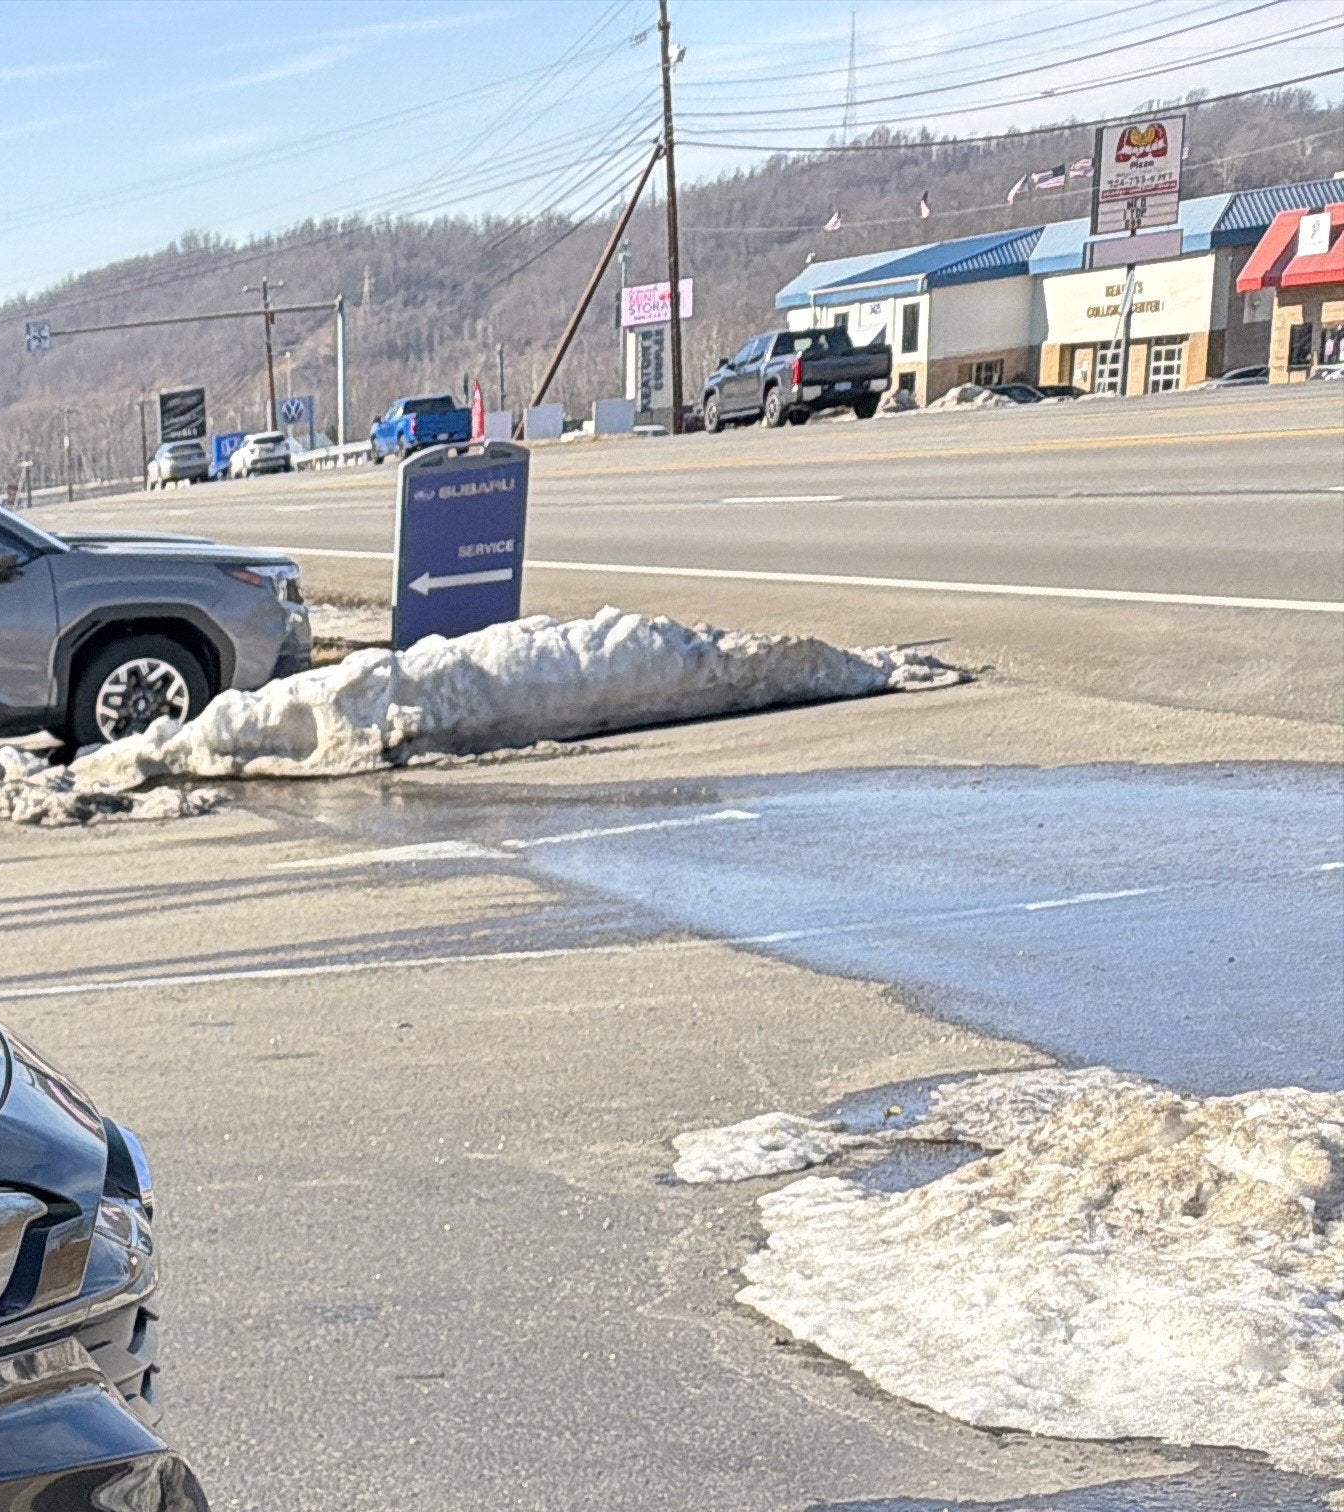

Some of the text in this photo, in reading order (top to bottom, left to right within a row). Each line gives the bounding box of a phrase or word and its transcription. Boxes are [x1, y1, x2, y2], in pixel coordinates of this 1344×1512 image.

[628, 301, 669, 315] STORA
[438, 478, 515, 499] SUBARU
[458, 538, 515, 558] SERVICE
